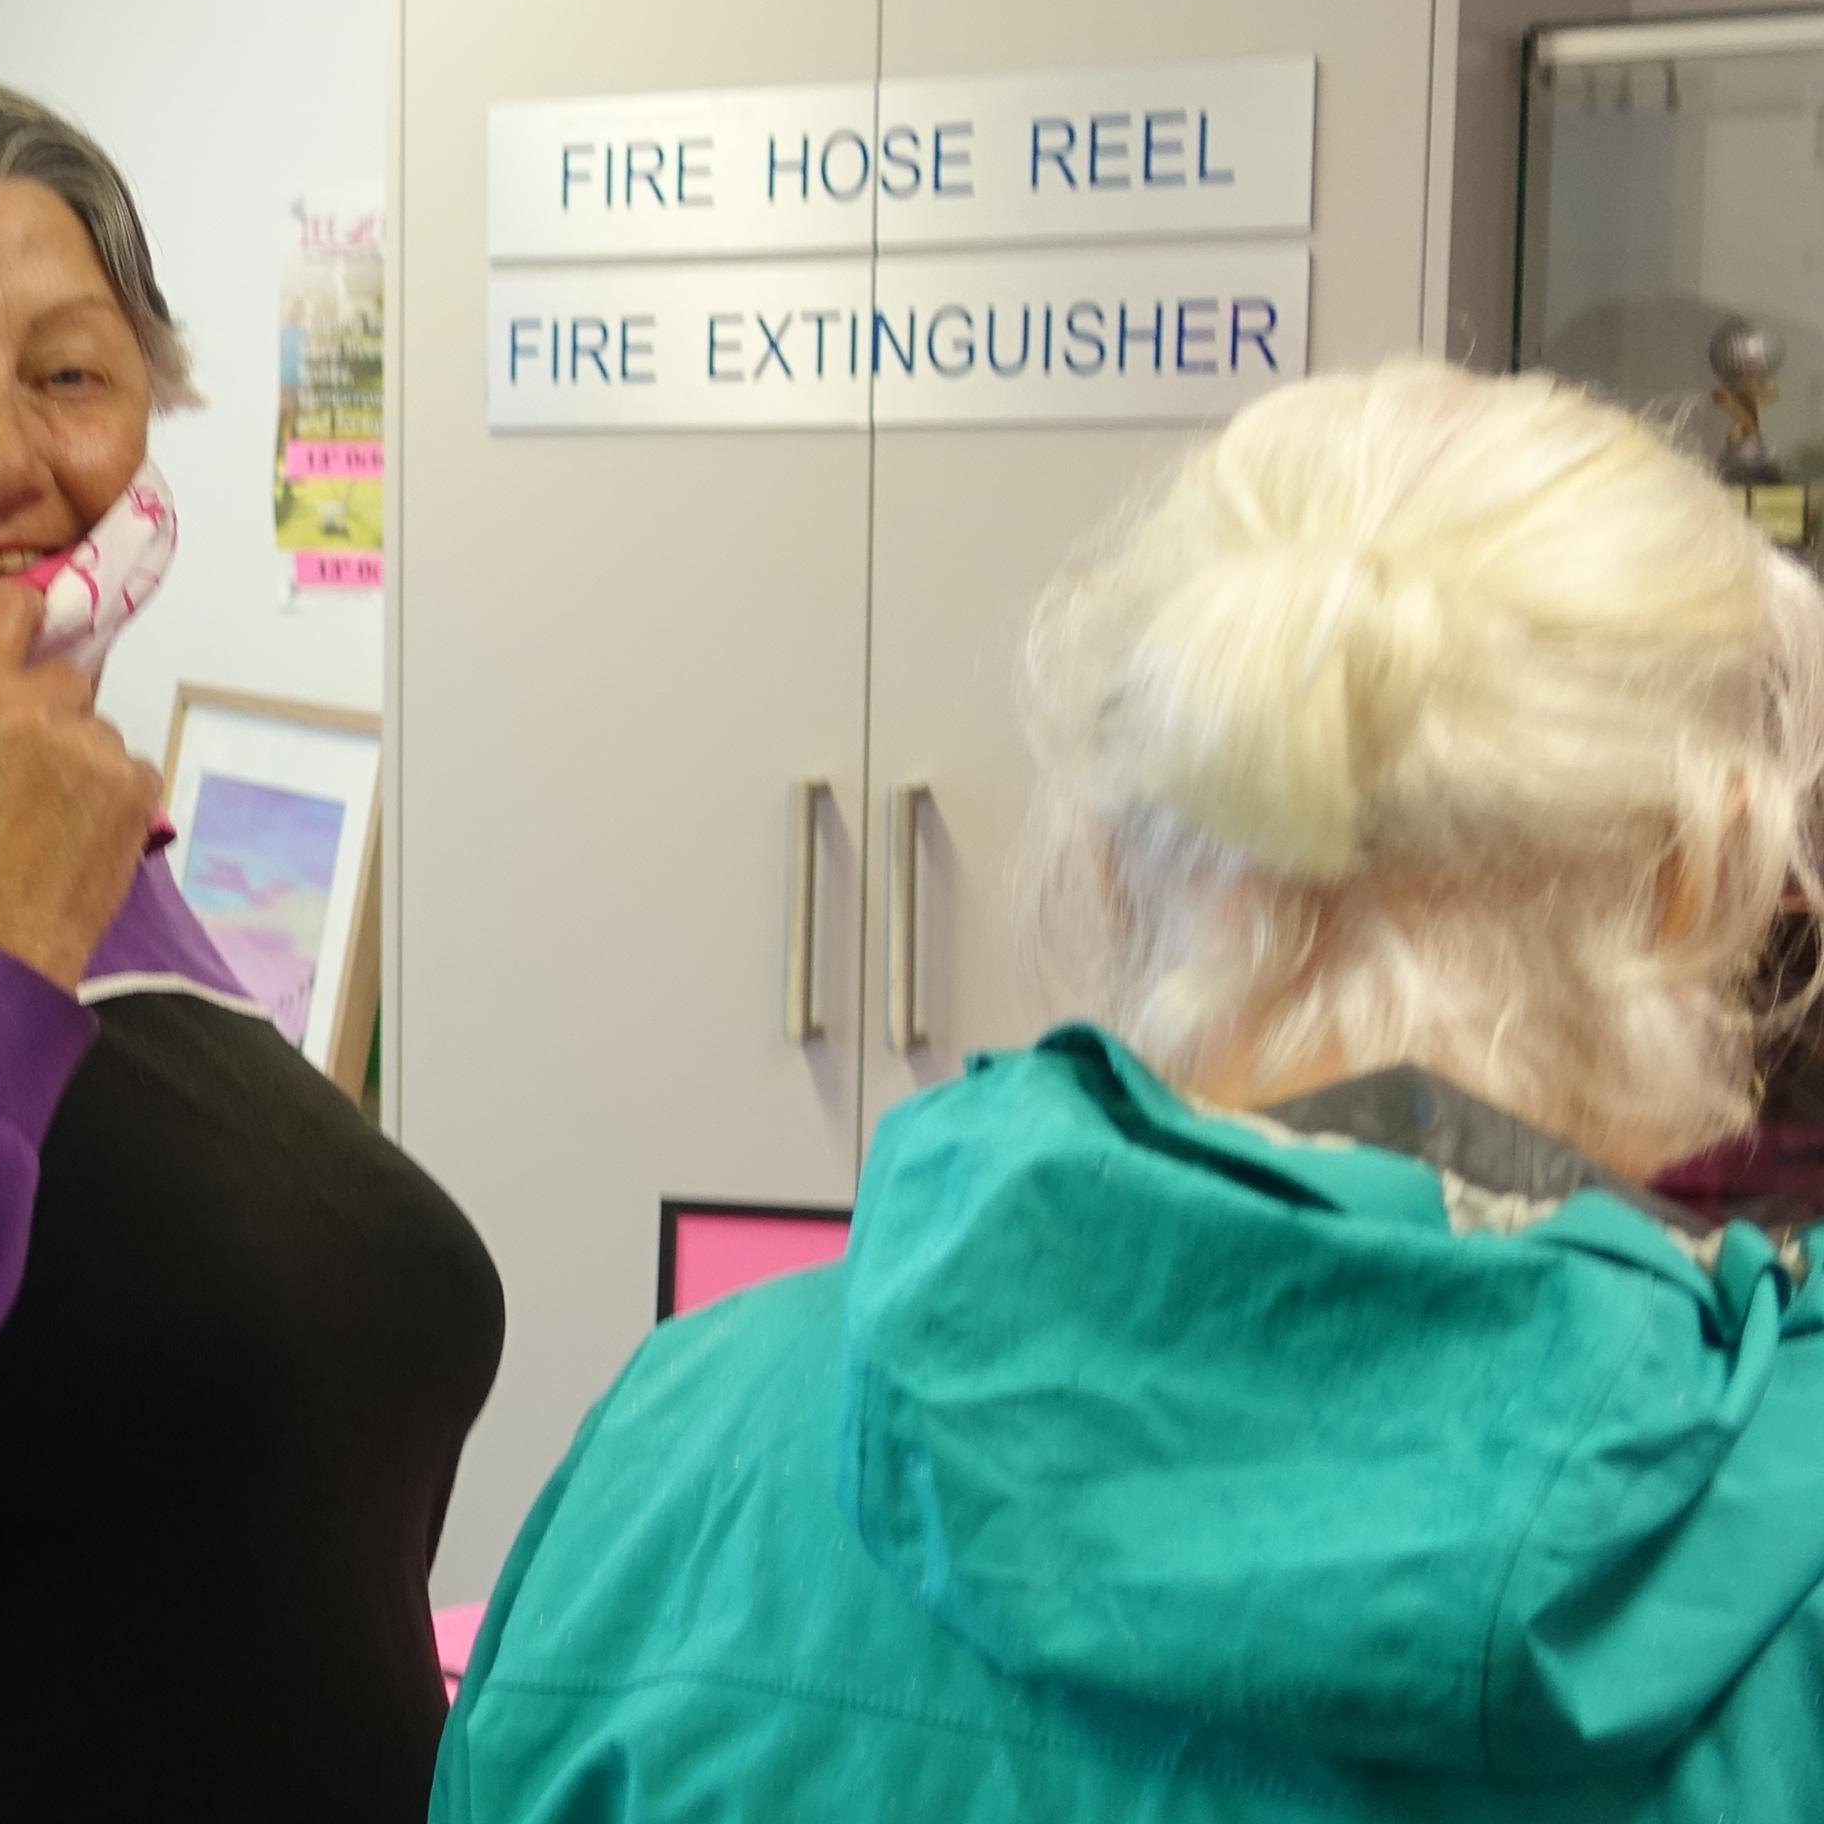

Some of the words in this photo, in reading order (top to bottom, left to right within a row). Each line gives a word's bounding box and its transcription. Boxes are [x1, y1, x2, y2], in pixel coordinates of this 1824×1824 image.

[562, 137, 714, 210] FIRE
[768, 121, 975, 203] HOSE
[1031, 109, 1236, 191] REEL
[509, 314, 656, 384] FIRE
[708, 295, 1279, 383] EXTINGUISHER
